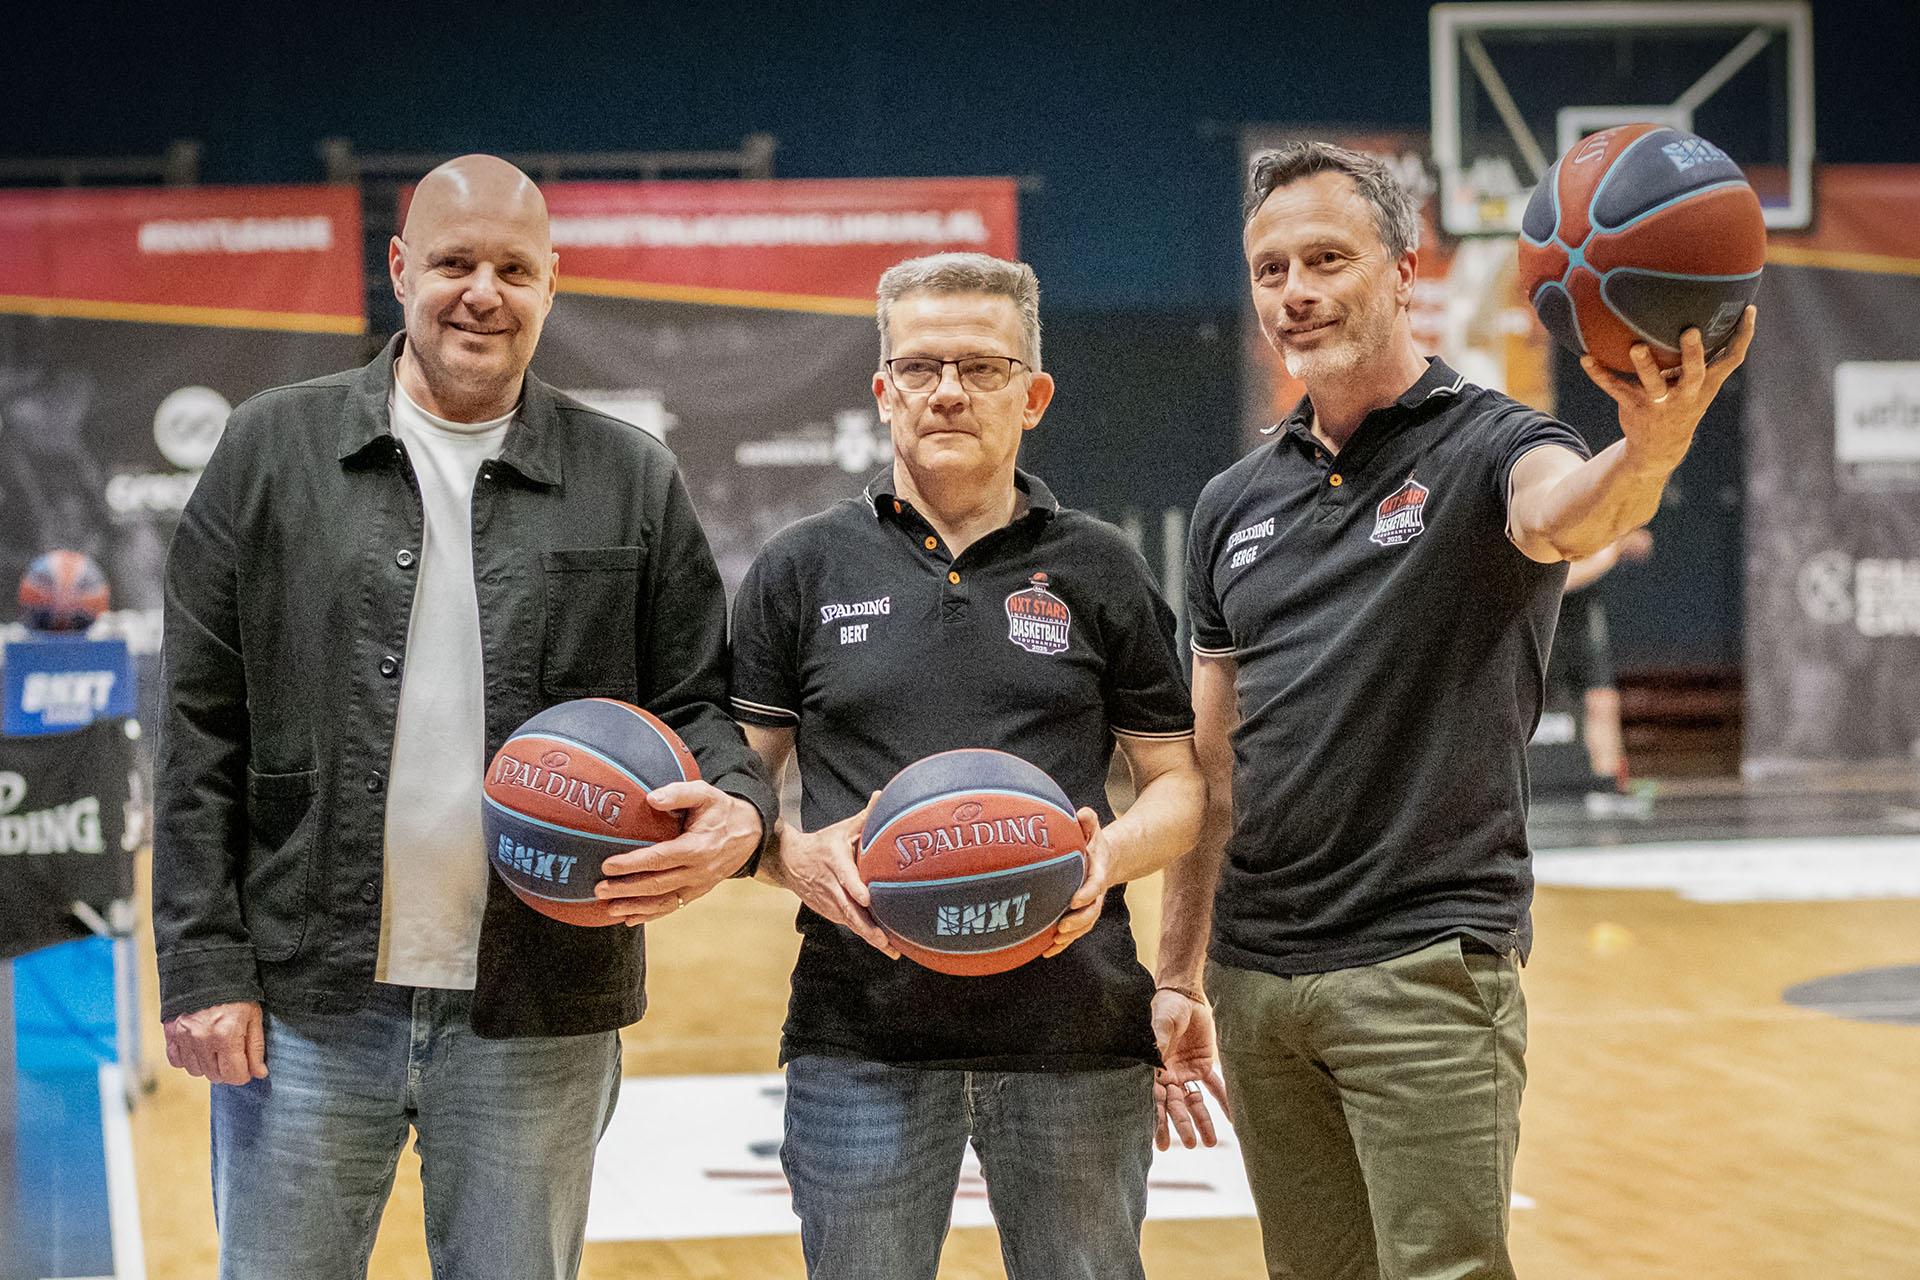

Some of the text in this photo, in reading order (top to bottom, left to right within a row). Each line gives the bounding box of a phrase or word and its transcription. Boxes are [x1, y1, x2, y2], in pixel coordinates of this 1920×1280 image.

[1226, 517, 1275, 552] SPALDING
[1375, 509, 1420, 534] BASKETBALL
[1230, 545, 1259, 569] SERGE
[820, 596, 891, 624] SPALDING
[1009, 597, 1067, 620] NXT STARS
[839, 623, 869, 646] BERT
[1012, 618, 1067, 645] BASKETBALL
[1018, 636, 1062, 649] TOURNAMENT
[491, 754, 627, 831] SPALDING
[894, 814, 1051, 872] SPALDING
[498, 833, 579, 885] BNXT
[936, 892, 1031, 936] BNXT
